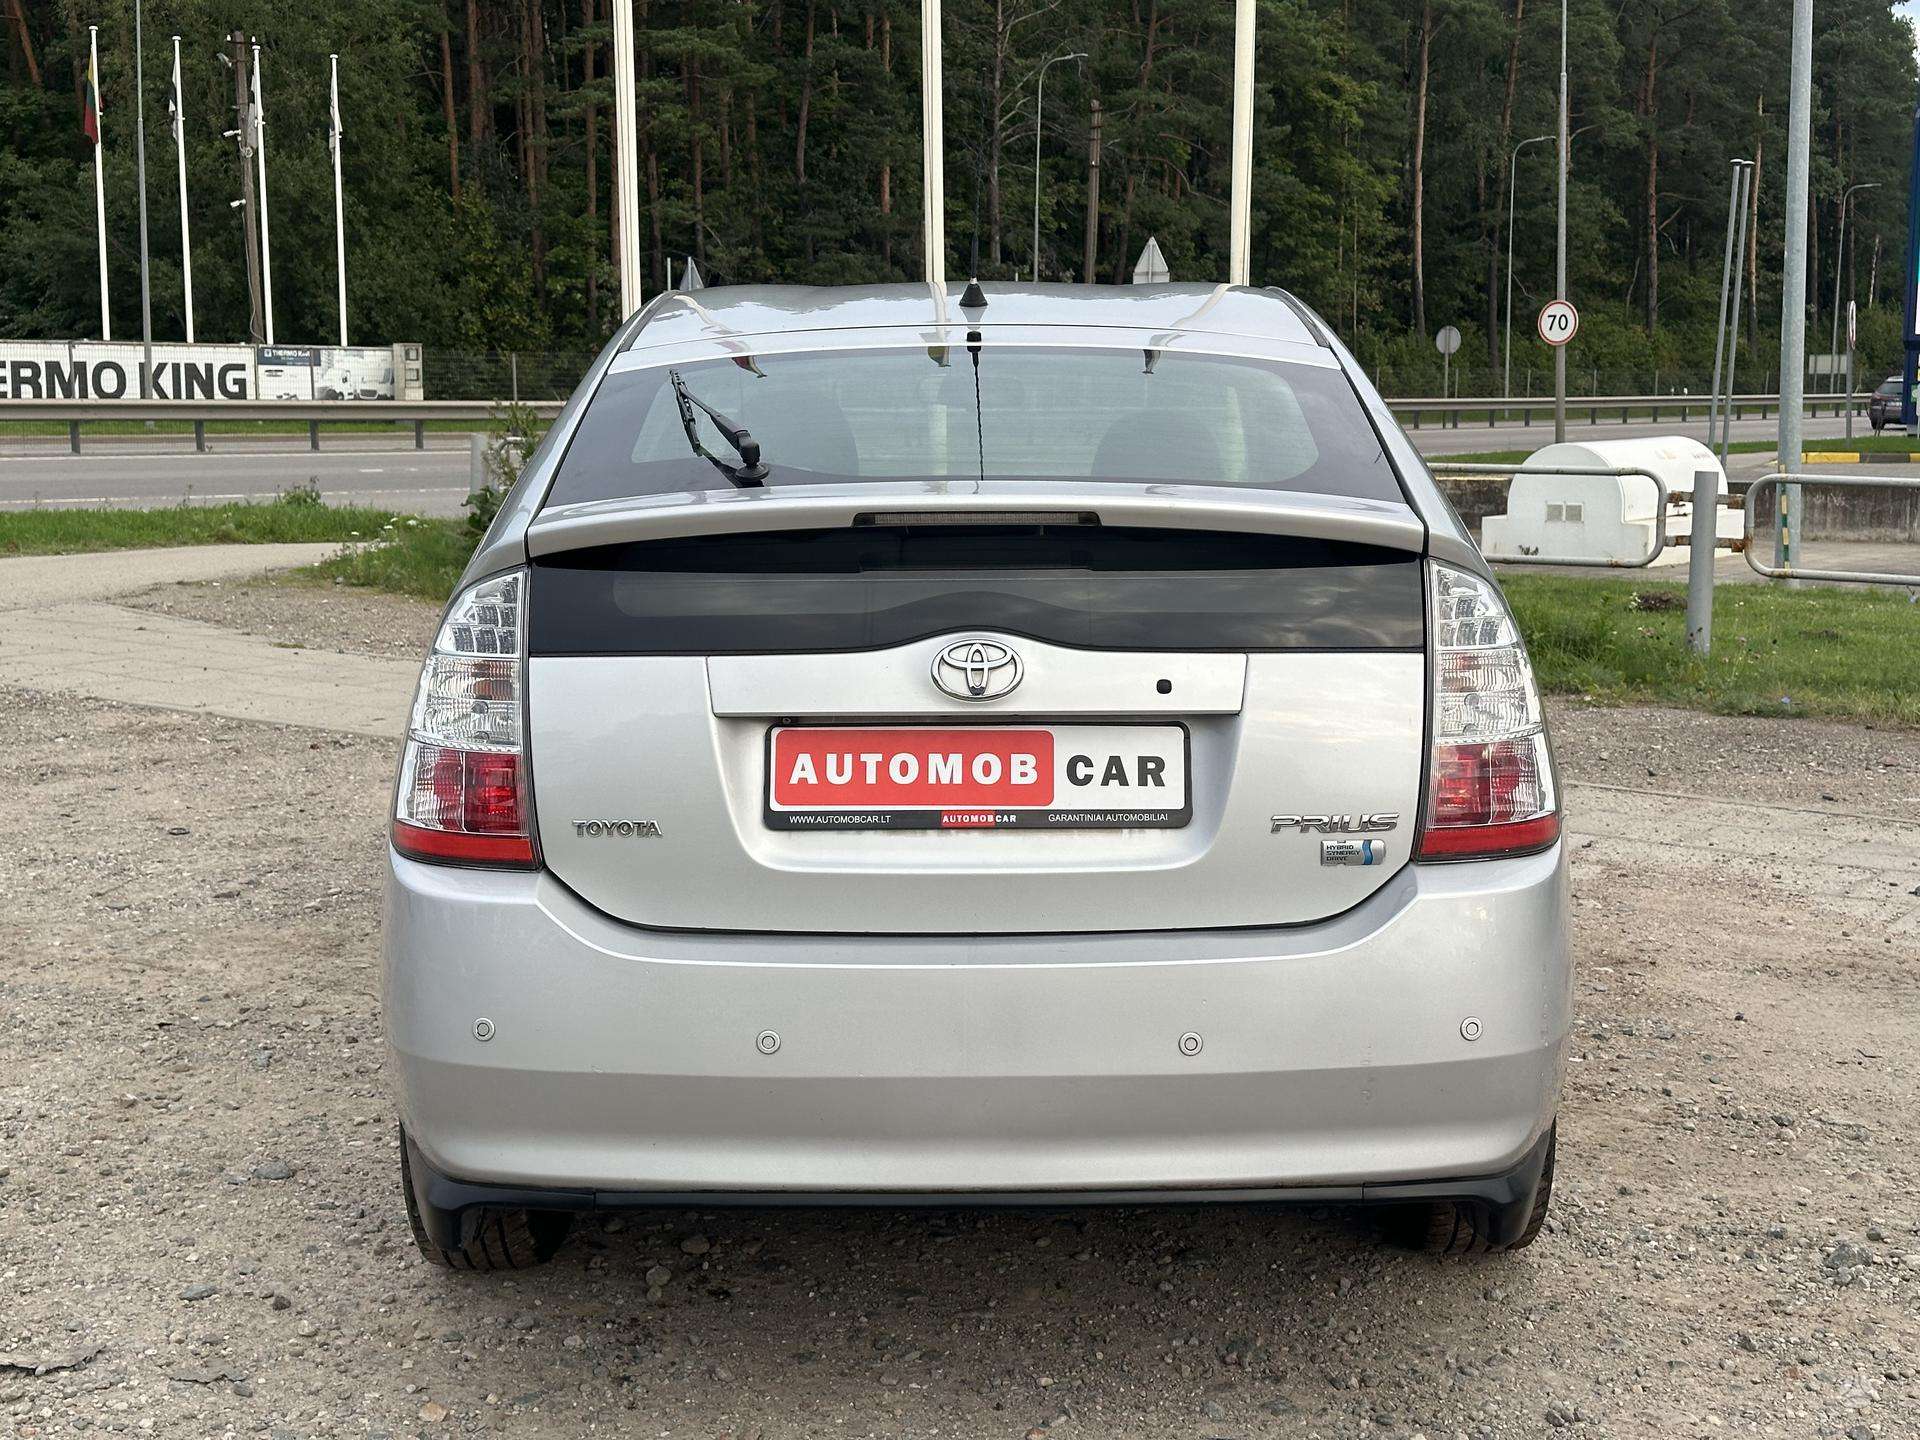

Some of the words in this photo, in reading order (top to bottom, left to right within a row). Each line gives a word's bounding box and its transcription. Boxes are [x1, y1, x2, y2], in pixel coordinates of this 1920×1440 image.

[1547, 314, 1568, 331] 70
[0, 360, 127, 399] RMO
[138, 362, 248, 400] KING
[788, 753, 1039, 785] AUTOMOB
[1066, 754, 1166, 787] CAR
[789, 815, 892, 824] WWW.AUTOMOBCAR.LT
[942, 814, 1017, 823] AUTOMOBCAR
[1048, 813, 1104, 822] GARANTINIAI
[1105, 813, 1168, 822] AUTOMOBILIAI
[1270, 812, 1400, 834] PRIUS
[572, 819, 663, 838] TOYOTA
